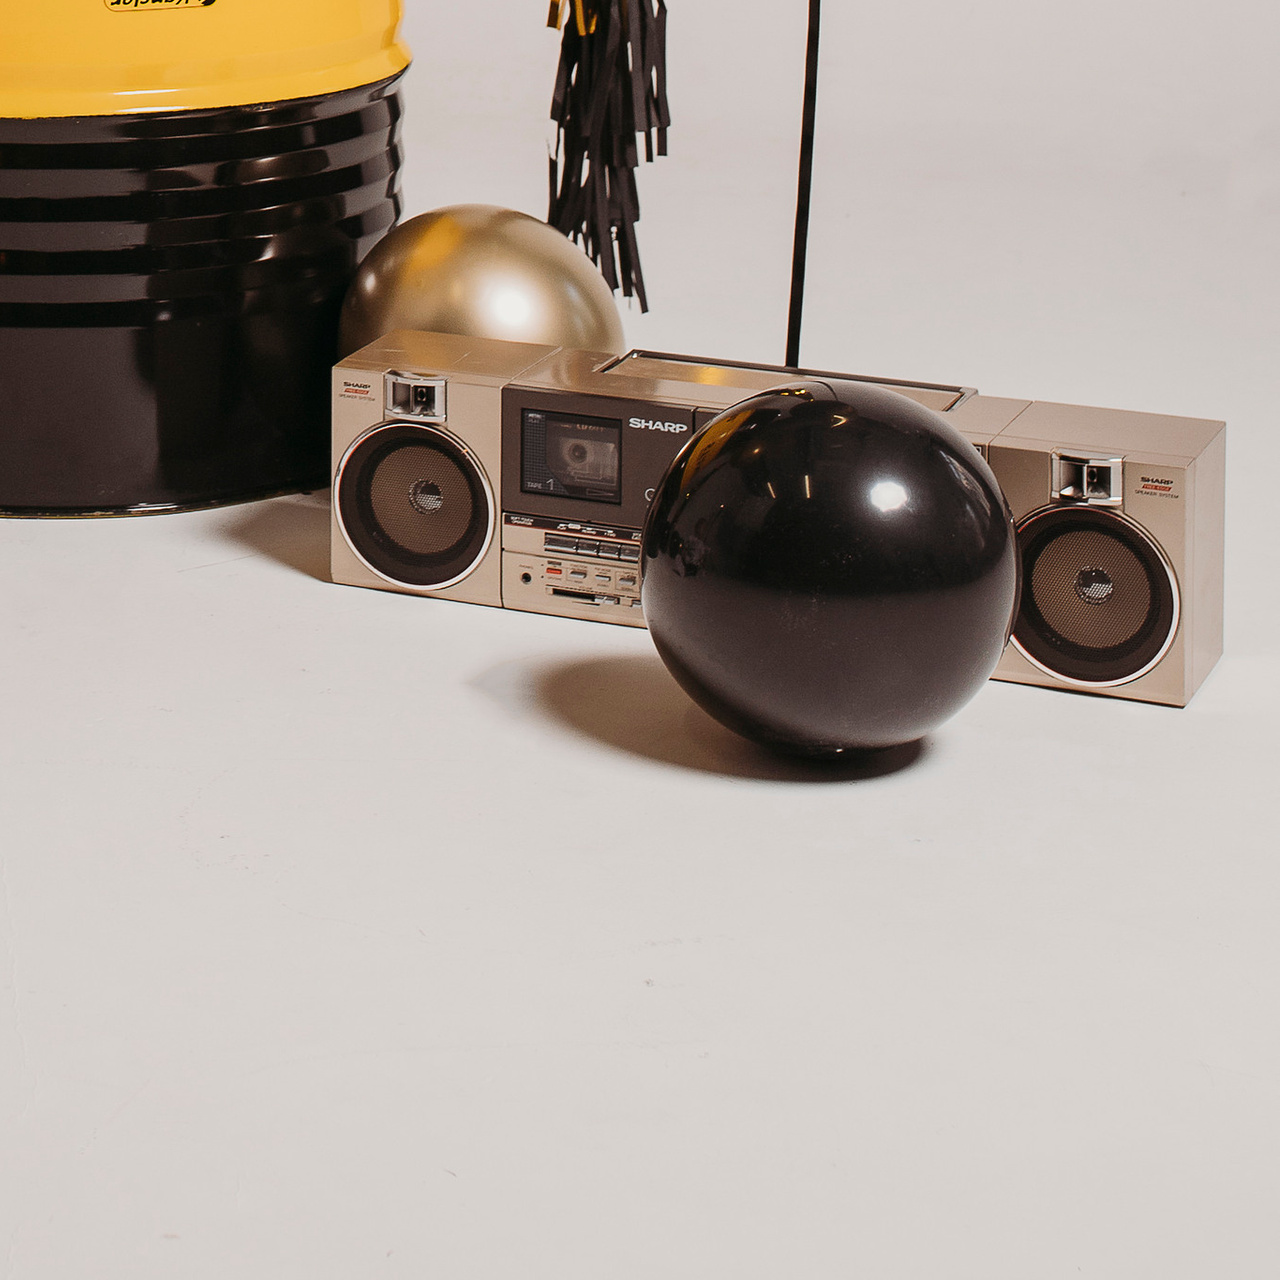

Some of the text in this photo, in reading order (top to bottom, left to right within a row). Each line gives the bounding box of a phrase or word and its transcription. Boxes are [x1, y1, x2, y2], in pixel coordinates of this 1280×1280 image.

[343, 381, 371, 389] SHARP
[628, 417, 689, 434] SHARP
[1140, 476, 1173, 484] SHARP
